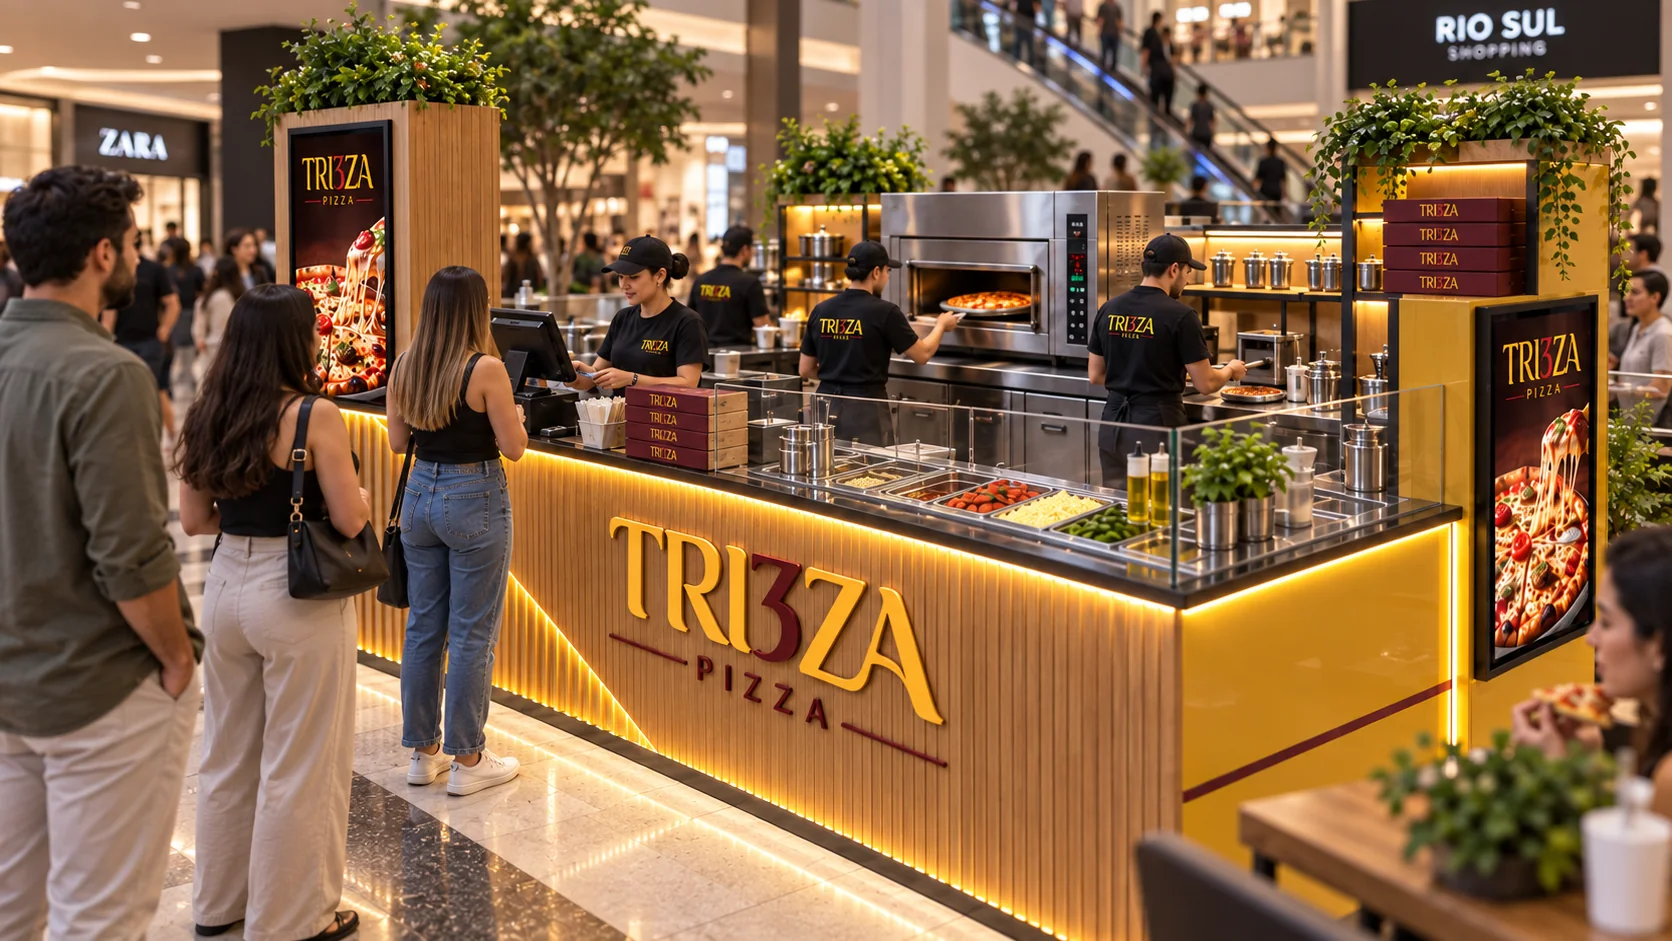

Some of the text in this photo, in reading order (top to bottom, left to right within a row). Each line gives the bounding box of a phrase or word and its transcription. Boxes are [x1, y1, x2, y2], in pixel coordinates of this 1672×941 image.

[1435, 7, 1566, 44] RIO SUL
[1447, 40, 1547, 62] SHOPPING
[98, 127, 168, 161] ZARA
[301, 153, 375, 191] TRI3ZA
[322, 195, 354, 206] PIZZA
[819, 318, 863, 336] TRI3ZA
[1107, 314, 1154, 335] TRI3ZA
[1502, 332, 1582, 385] TRI3ZA
[1526, 383, 1561, 400] PIZZA
[609, 516, 945, 726] TRI3ZA
[696, 655, 829, 730] PIZZA
